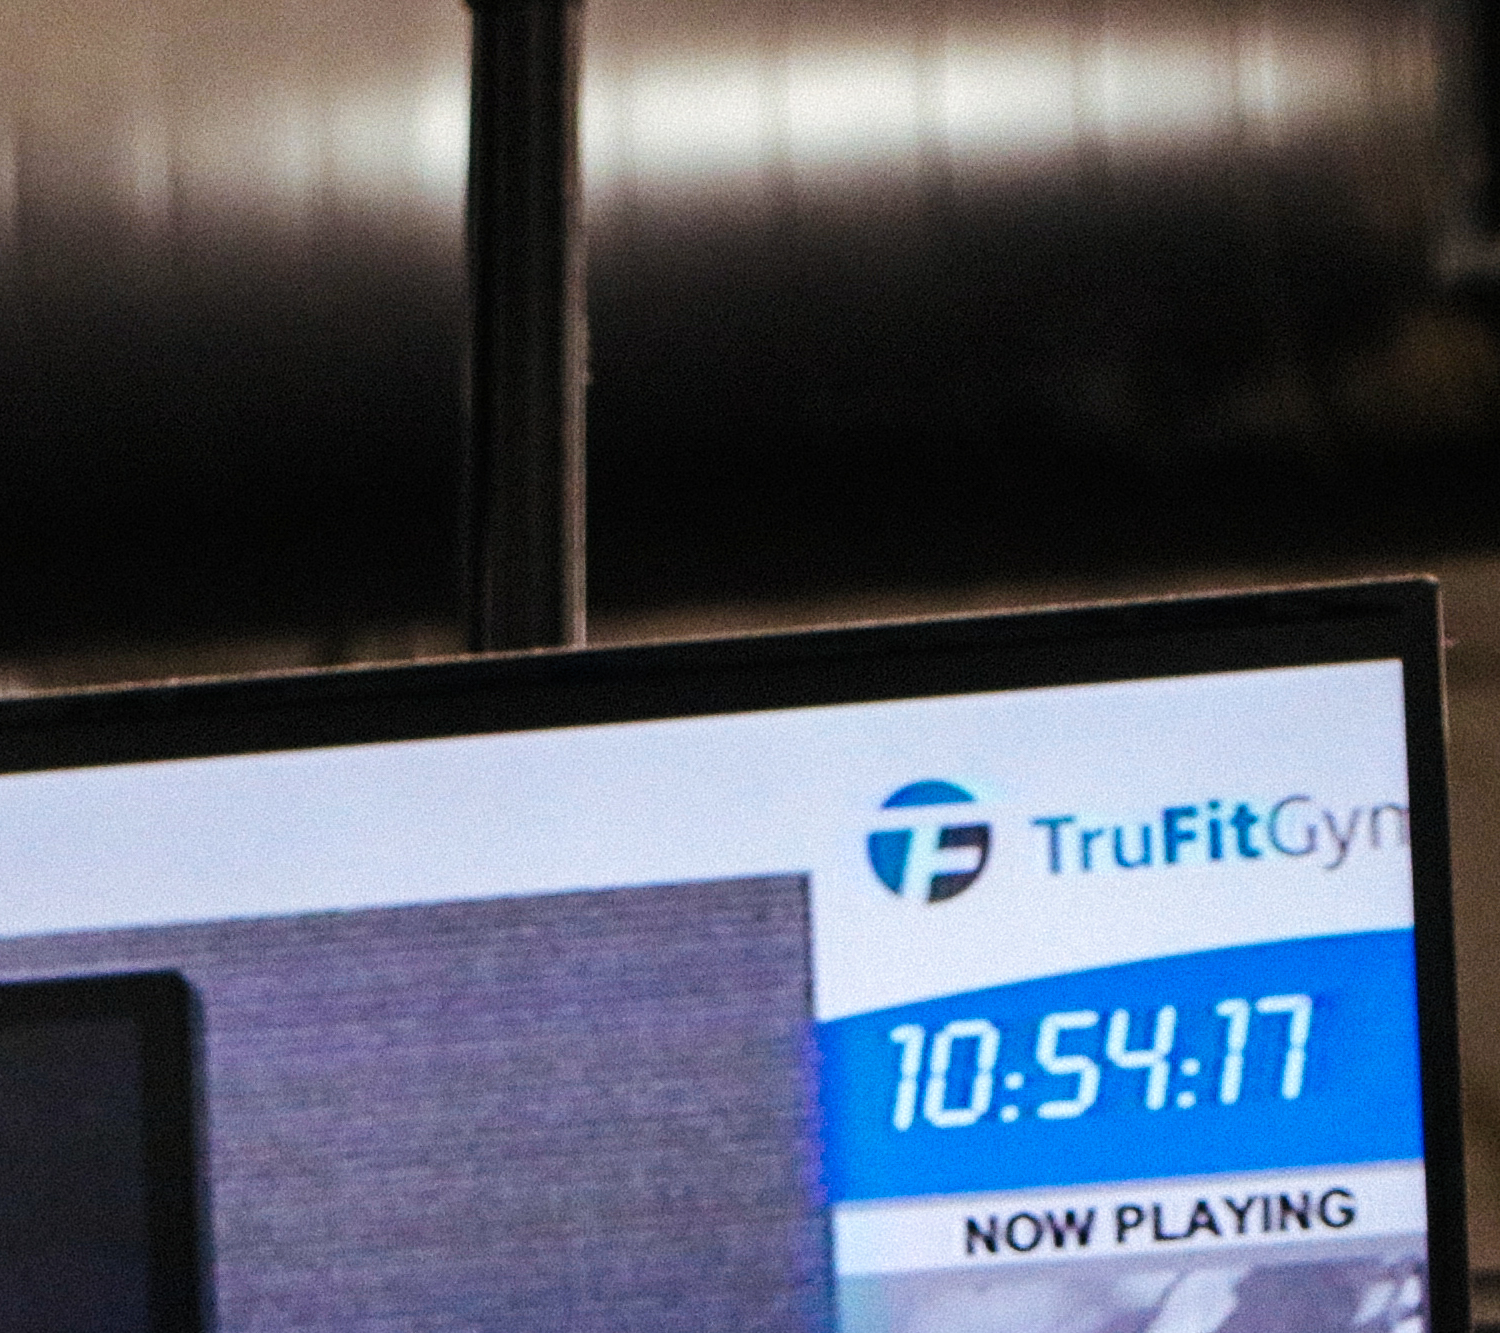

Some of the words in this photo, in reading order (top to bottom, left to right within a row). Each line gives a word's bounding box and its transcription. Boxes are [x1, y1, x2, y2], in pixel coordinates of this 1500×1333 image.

[888, 993, 1313, 1133] 10:54:17
[964, 1207, 1097, 1256] NOW
[1114, 1187, 1357, 1244] PLAYING
